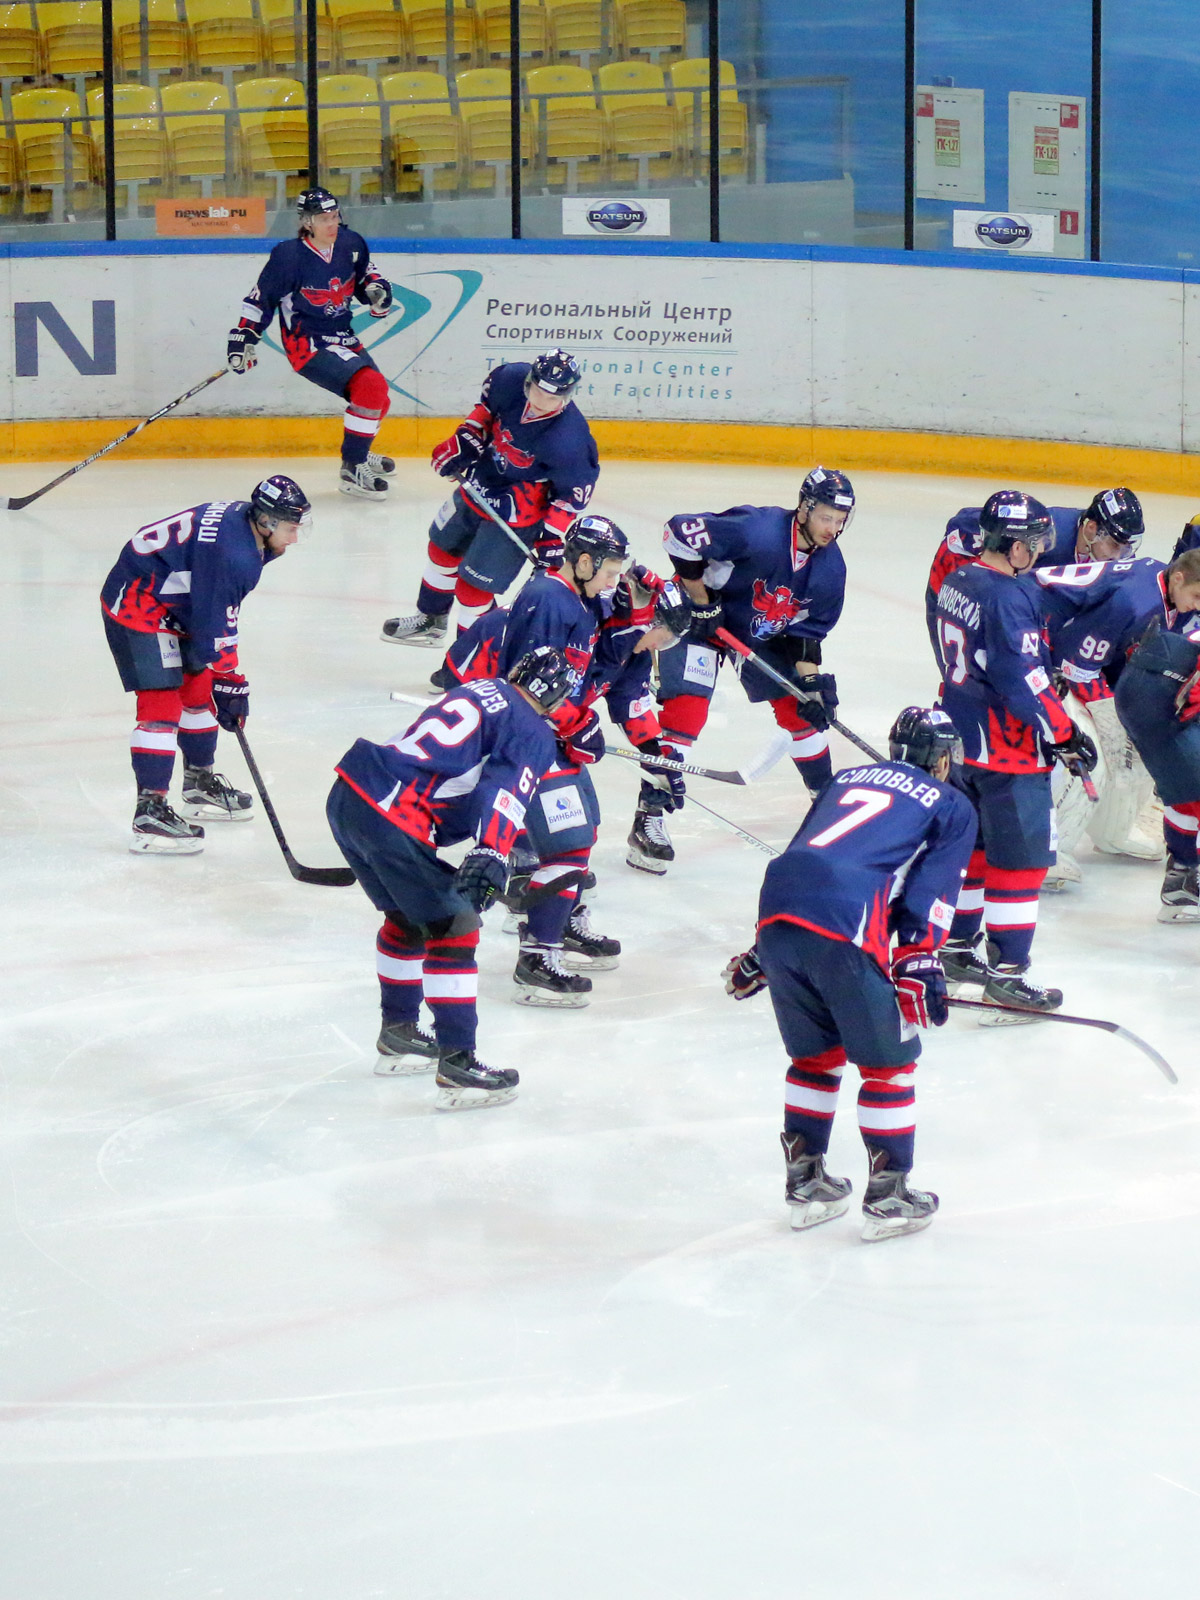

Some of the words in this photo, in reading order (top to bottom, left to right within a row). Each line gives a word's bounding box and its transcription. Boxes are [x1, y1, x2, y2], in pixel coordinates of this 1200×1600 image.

[175, 206, 247, 218] newslab.ru
[981, 226, 1026, 236] DATSUN
[486, 298, 651, 318] Региональный
[664, 302, 732, 325] Центр
[14, 300, 117, 377] N
[486, 324, 603, 343] Спортивных
[613, 326, 732, 345] Сооружений
[653, 361, 733, 376] Center
[614, 383, 733, 400] Facilities
[681, 517, 712, 550] 35
[1021, 632, 1039, 657] 47
[1079, 635, 1110, 660] 99
[528, 678, 549, 698] 62
[900, 743, 908, 760] 7
[643, 753, 707, 776] SUPREME
[836, 768, 941, 808] СОЛОВЬЕВ
[547, 809, 584, 824] БИНБАНК
[807, 788, 893, 848] 7
[735, 831, 776, 856] EASTON
